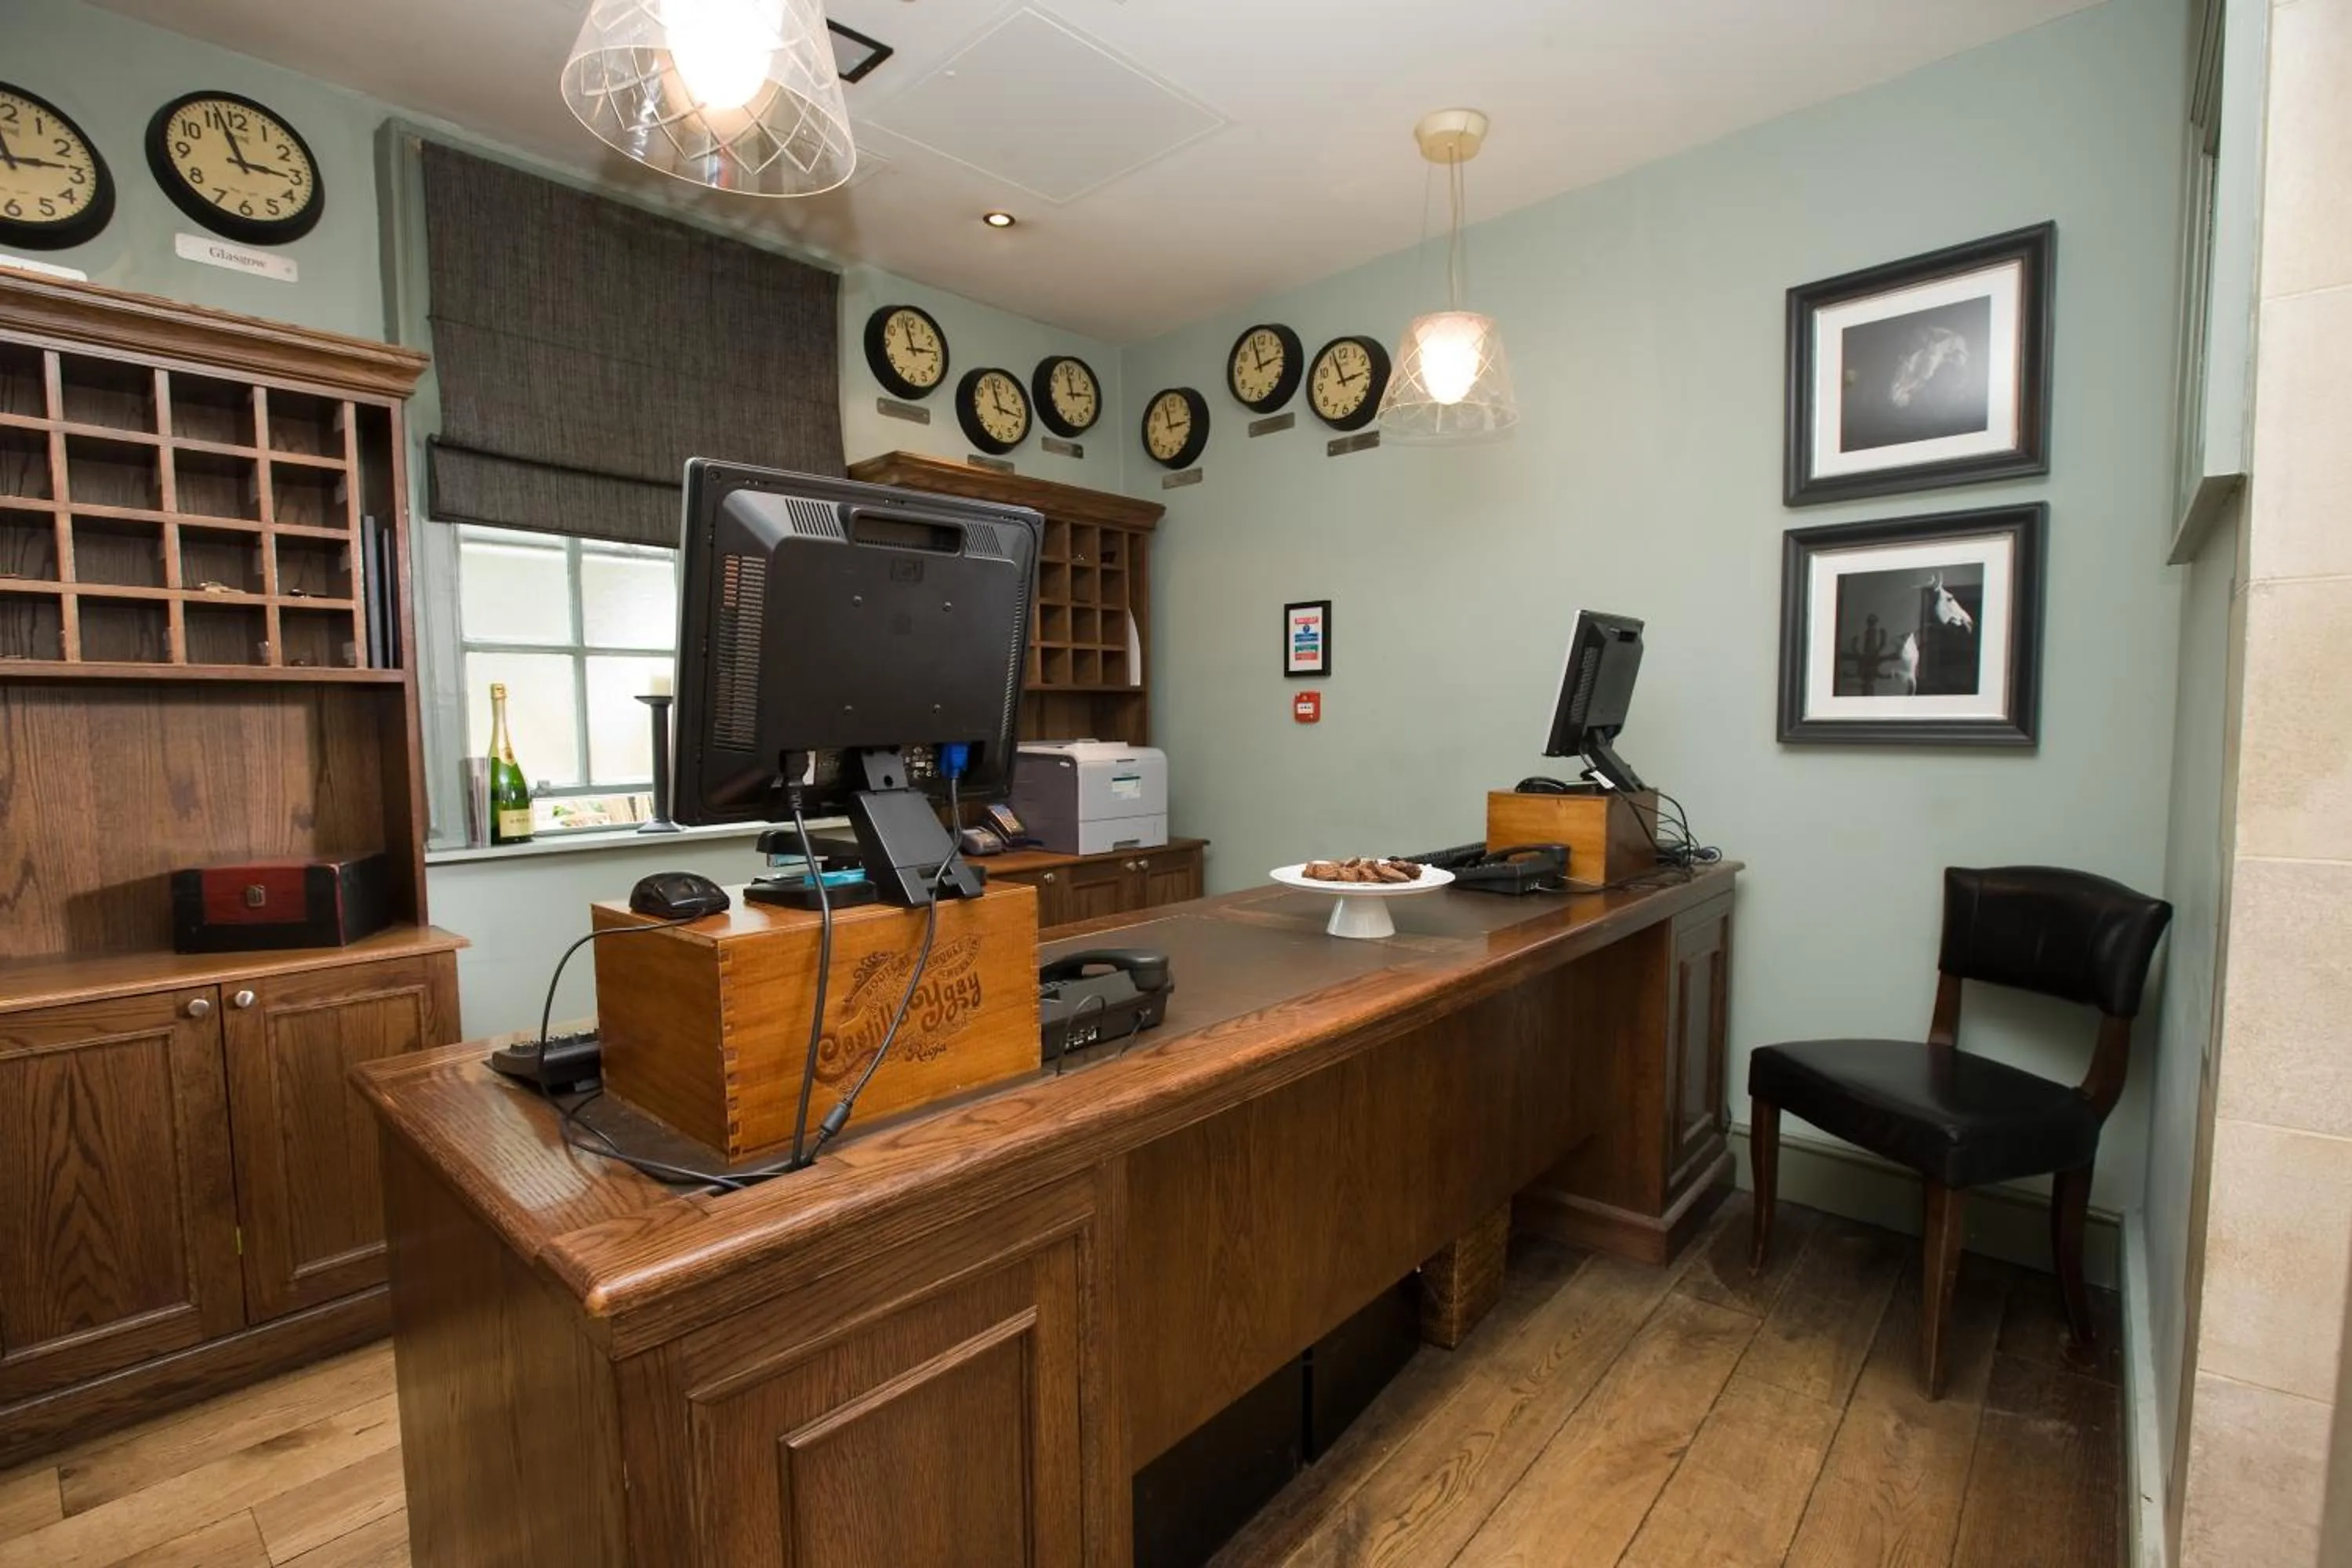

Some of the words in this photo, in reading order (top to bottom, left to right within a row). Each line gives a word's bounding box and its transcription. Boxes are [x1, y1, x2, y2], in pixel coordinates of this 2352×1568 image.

[0, 103, 20, 124] 2
[205, 111, 219, 130] 11
[228, 111, 249, 132] 12
[35, 116, 43, 135] 1
[182, 119, 201, 140] 10
[261, 125, 267, 142] 1
[53, 139, 71, 158] 2
[175, 141, 191, 158] 9
[277, 144, 291, 162] 2
[68, 165, 85, 184] 3
[190, 166, 204, 184] 8
[289, 169, 303, 186] 3
[58, 187, 77, 205] 4
[212, 187, 228, 204] 7
[280, 189, 296, 204] 4
[4, 198, 23, 217] 6
[38, 197, 56, 217] 5
[238, 201, 253, 216] 6
[266, 198, 280, 216] 5
[209, 247, 267, 267] Glasgow
[927, 335, 934, 347] 2
[1257, 335, 1265, 346] 12
[1338, 348, 1348, 359] 12
[1359, 354, 1367, 365] 2
[898, 366, 906, 376] 7
[921, 371, 927, 382] 5
[927, 364, 935, 374] 4
[1320, 367, 1328, 379] 10
[909, 373, 916, 383] 6
[1083, 380, 1089, 390] 2
[1247, 387, 1255, 398] 7
[1257, 389, 1263, 399] 6
[1317, 383, 1323, 394] 9
[1323, 396, 1329, 407] 8
[1331, 404, 1338, 415] 7
[1341, 404, 1349, 415] 6
[1354, 396, 1360, 407] 5
[909, 971, 981, 1032] Ygay
